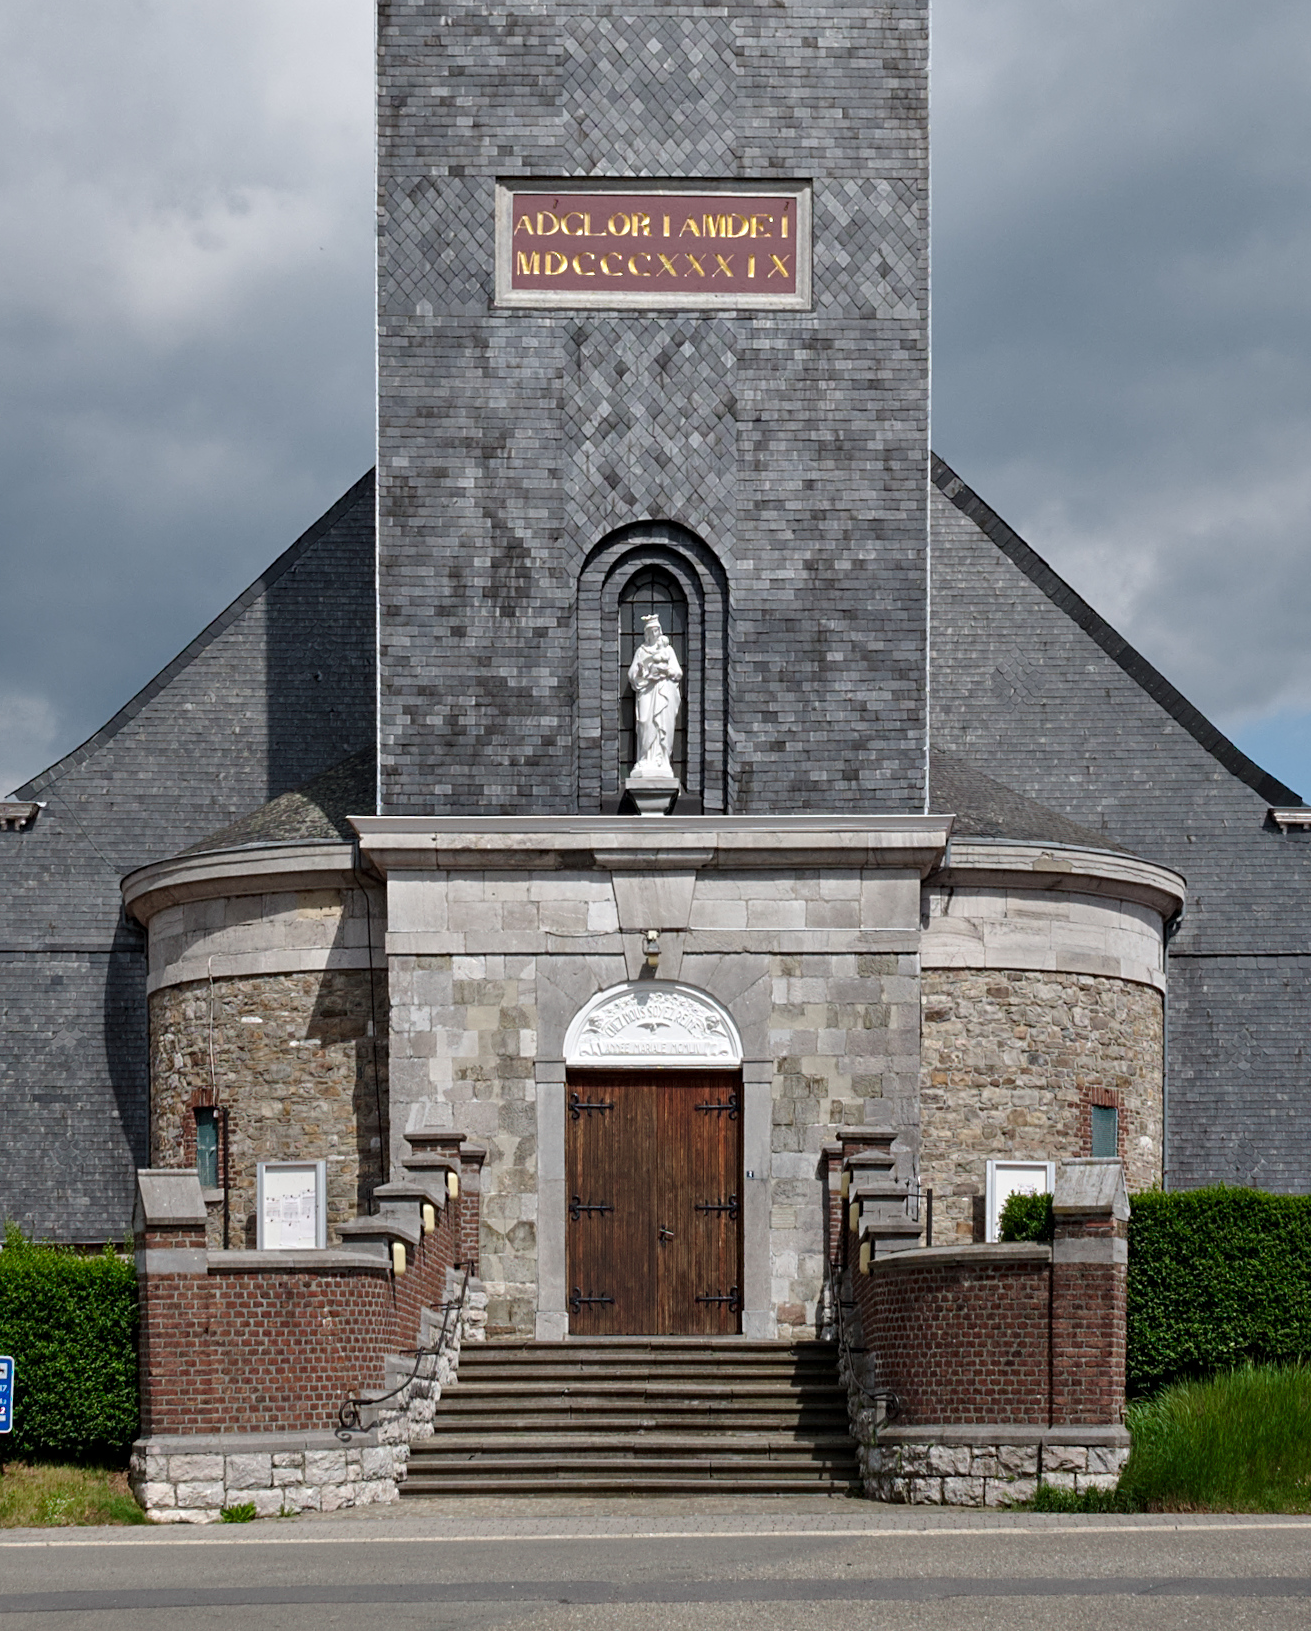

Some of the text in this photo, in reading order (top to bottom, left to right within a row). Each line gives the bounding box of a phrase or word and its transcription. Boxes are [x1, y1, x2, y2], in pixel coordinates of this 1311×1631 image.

[517, 251, 790, 278] MDCCCXXXIX
[622, 1007, 646, 1025] NOUS
[647, 1005, 675, 1022] SOYEZ
[673, 1010, 701, 1038] REINE
[633, 1043, 667, 1055] MARIALE
[0, 1384, 7, 1392] 17
